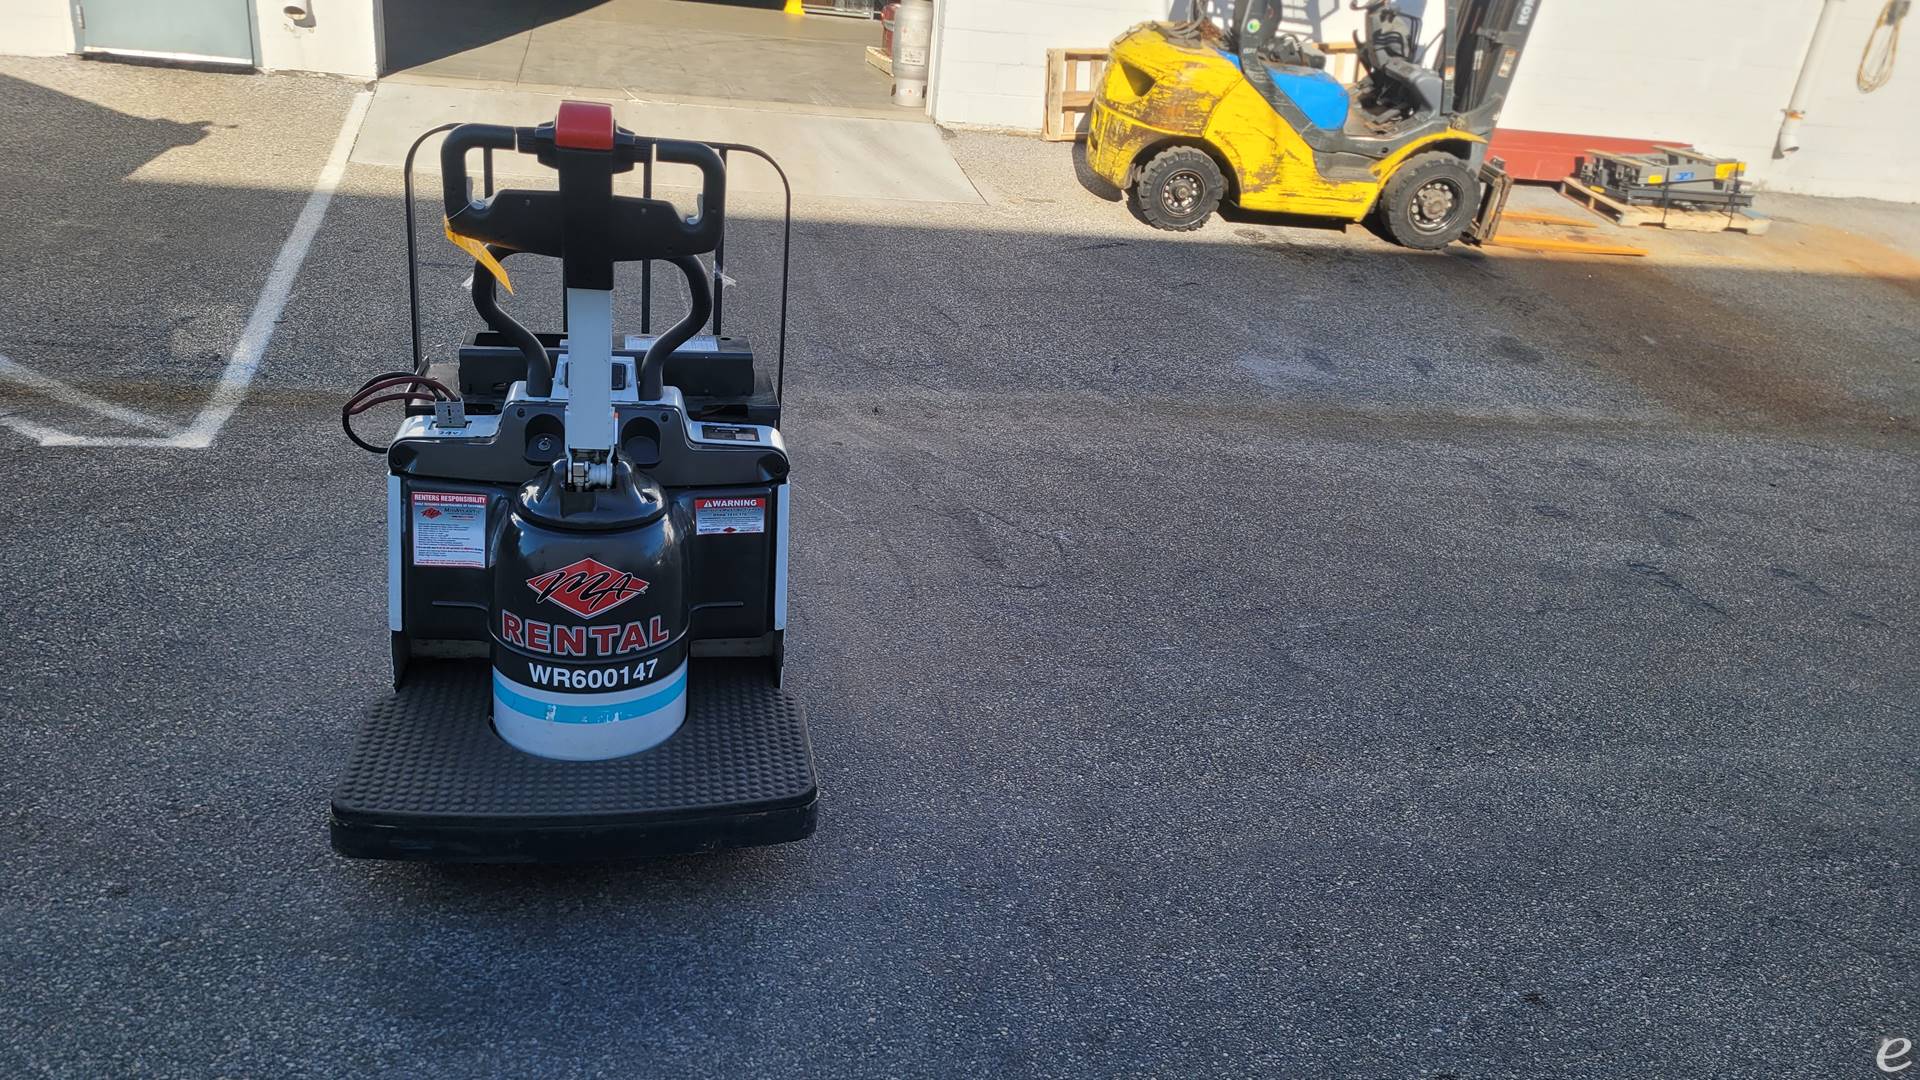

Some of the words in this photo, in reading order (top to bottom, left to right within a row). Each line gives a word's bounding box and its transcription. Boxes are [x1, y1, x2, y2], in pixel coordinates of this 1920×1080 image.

[440, 495, 486, 503] RESPONSIBILITY
[712, 499, 757, 507] WARNING
[502, 609, 669, 656] RENTAL
[528, 658, 658, 688] WR600147
